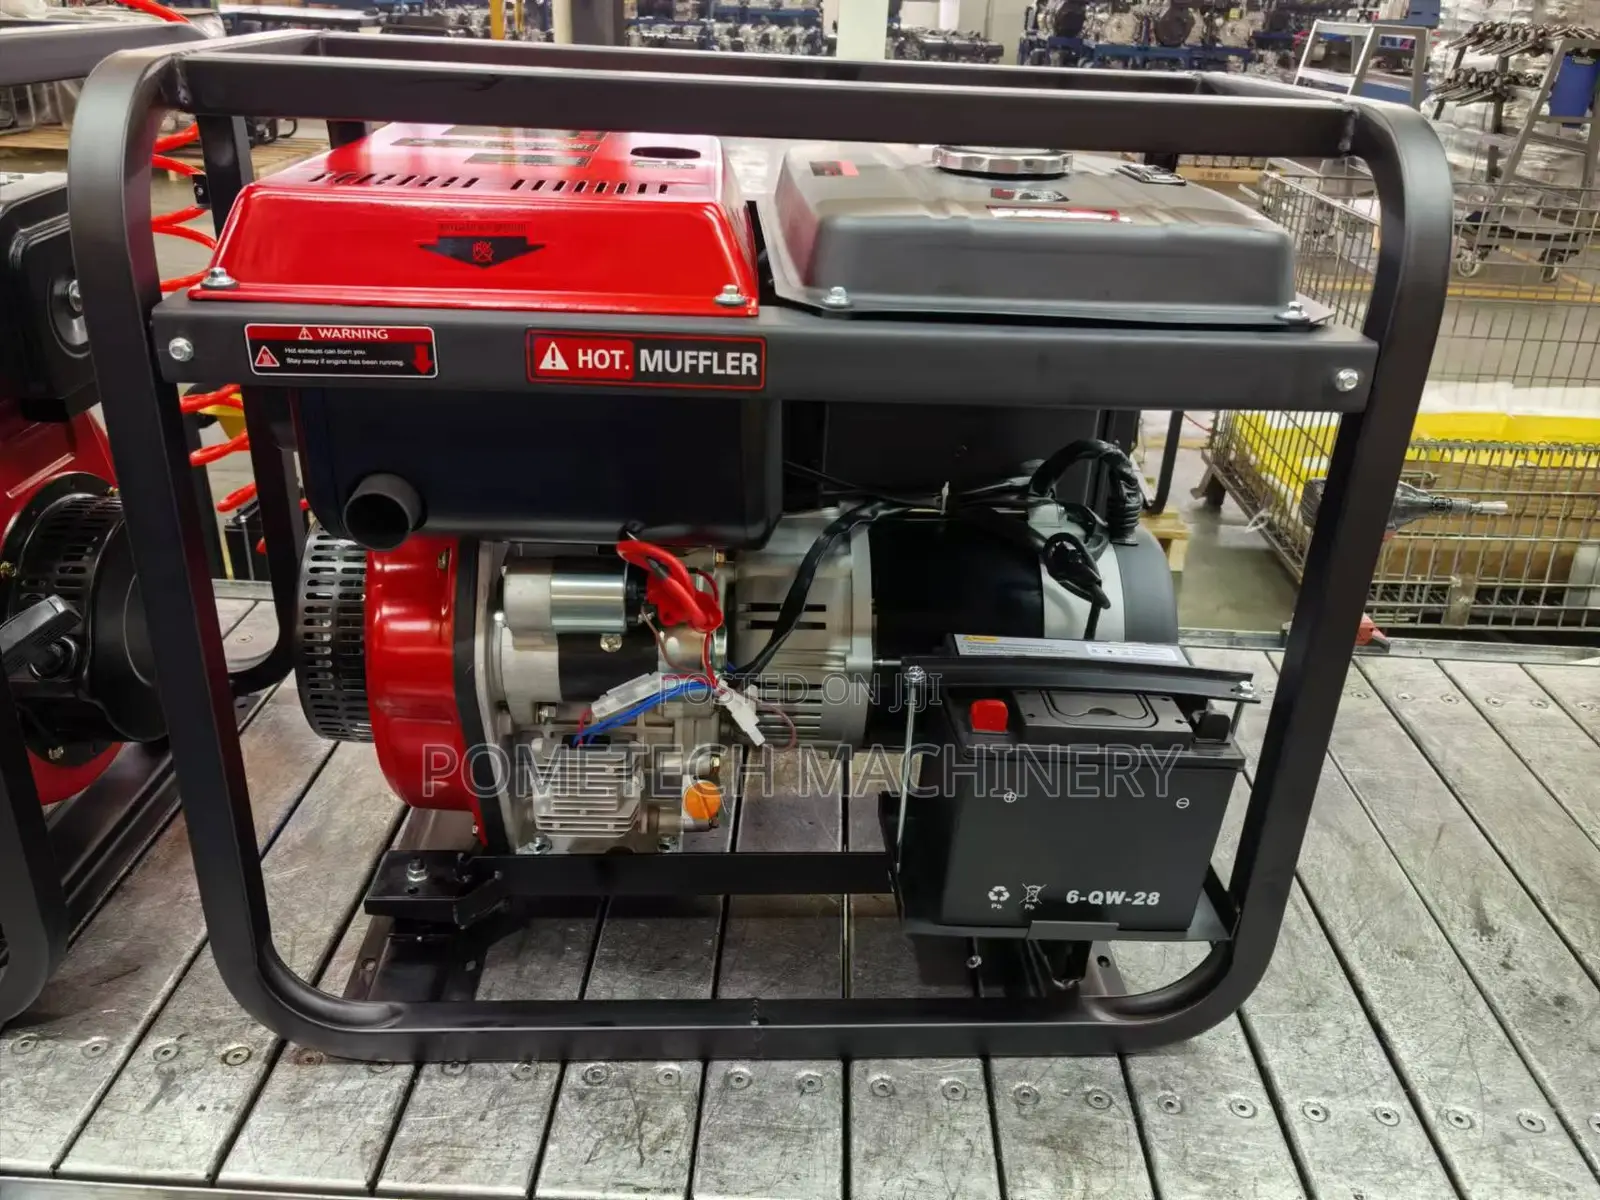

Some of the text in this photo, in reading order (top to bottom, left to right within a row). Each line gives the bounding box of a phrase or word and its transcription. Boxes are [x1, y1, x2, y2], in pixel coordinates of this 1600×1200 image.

[317, 328, 389, 340] WARNING
[297, 347, 323, 355] exhaust
[286, 357, 301, 365] Stay
[302, 358, 319, 366] away
[326, 358, 348, 366] engine
[577, 348, 758, 375] HOT. MUFFLER
[1066, 889, 1161, 906] 6-QW-28
